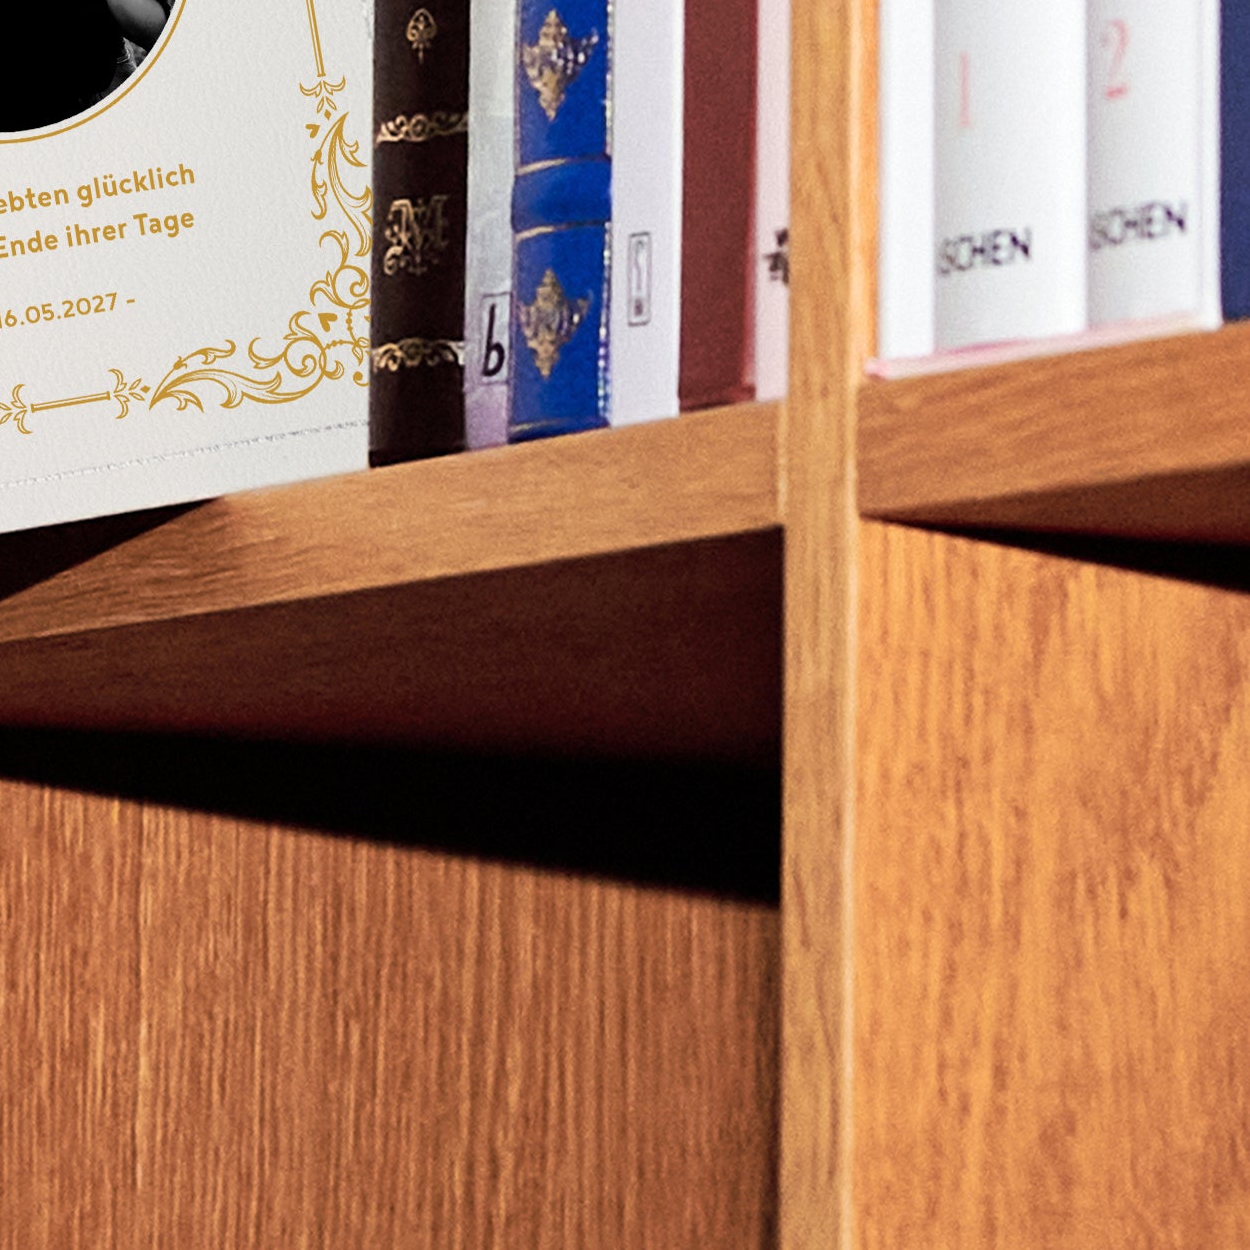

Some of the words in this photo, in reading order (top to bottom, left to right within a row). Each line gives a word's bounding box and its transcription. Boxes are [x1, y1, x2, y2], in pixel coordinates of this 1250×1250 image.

[1102, 17, 1131, 102] 2
[76, 163, 196, 209] glücklich
[65, 222, 127, 248] ihrer
[132, 212, 195, 239] Tage
